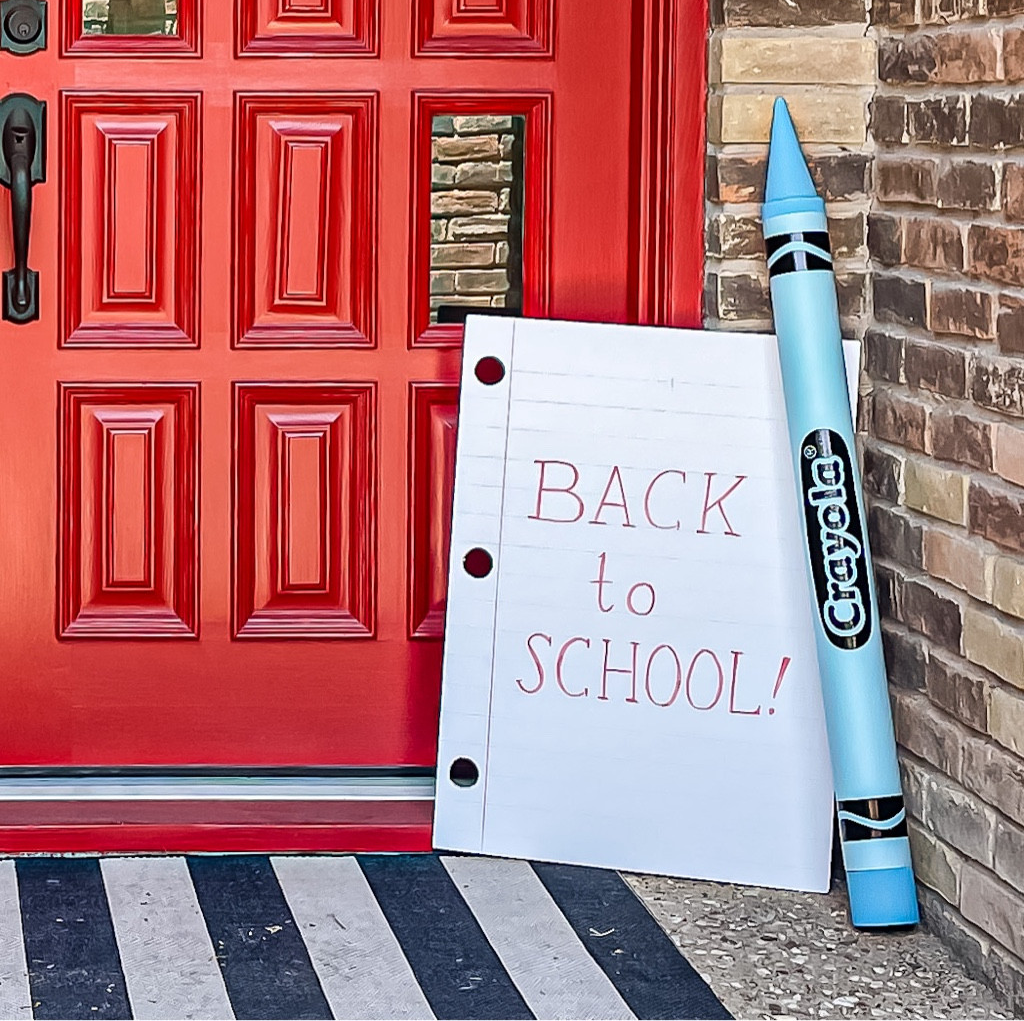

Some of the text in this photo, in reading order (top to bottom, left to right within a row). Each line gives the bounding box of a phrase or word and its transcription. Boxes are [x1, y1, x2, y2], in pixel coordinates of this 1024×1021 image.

[527, 459, 748, 537] BACK
[590, 552, 656, 616] to
[807, 455, 866, 637] Crayola
[516, 632, 791, 716] SCHOOL!
